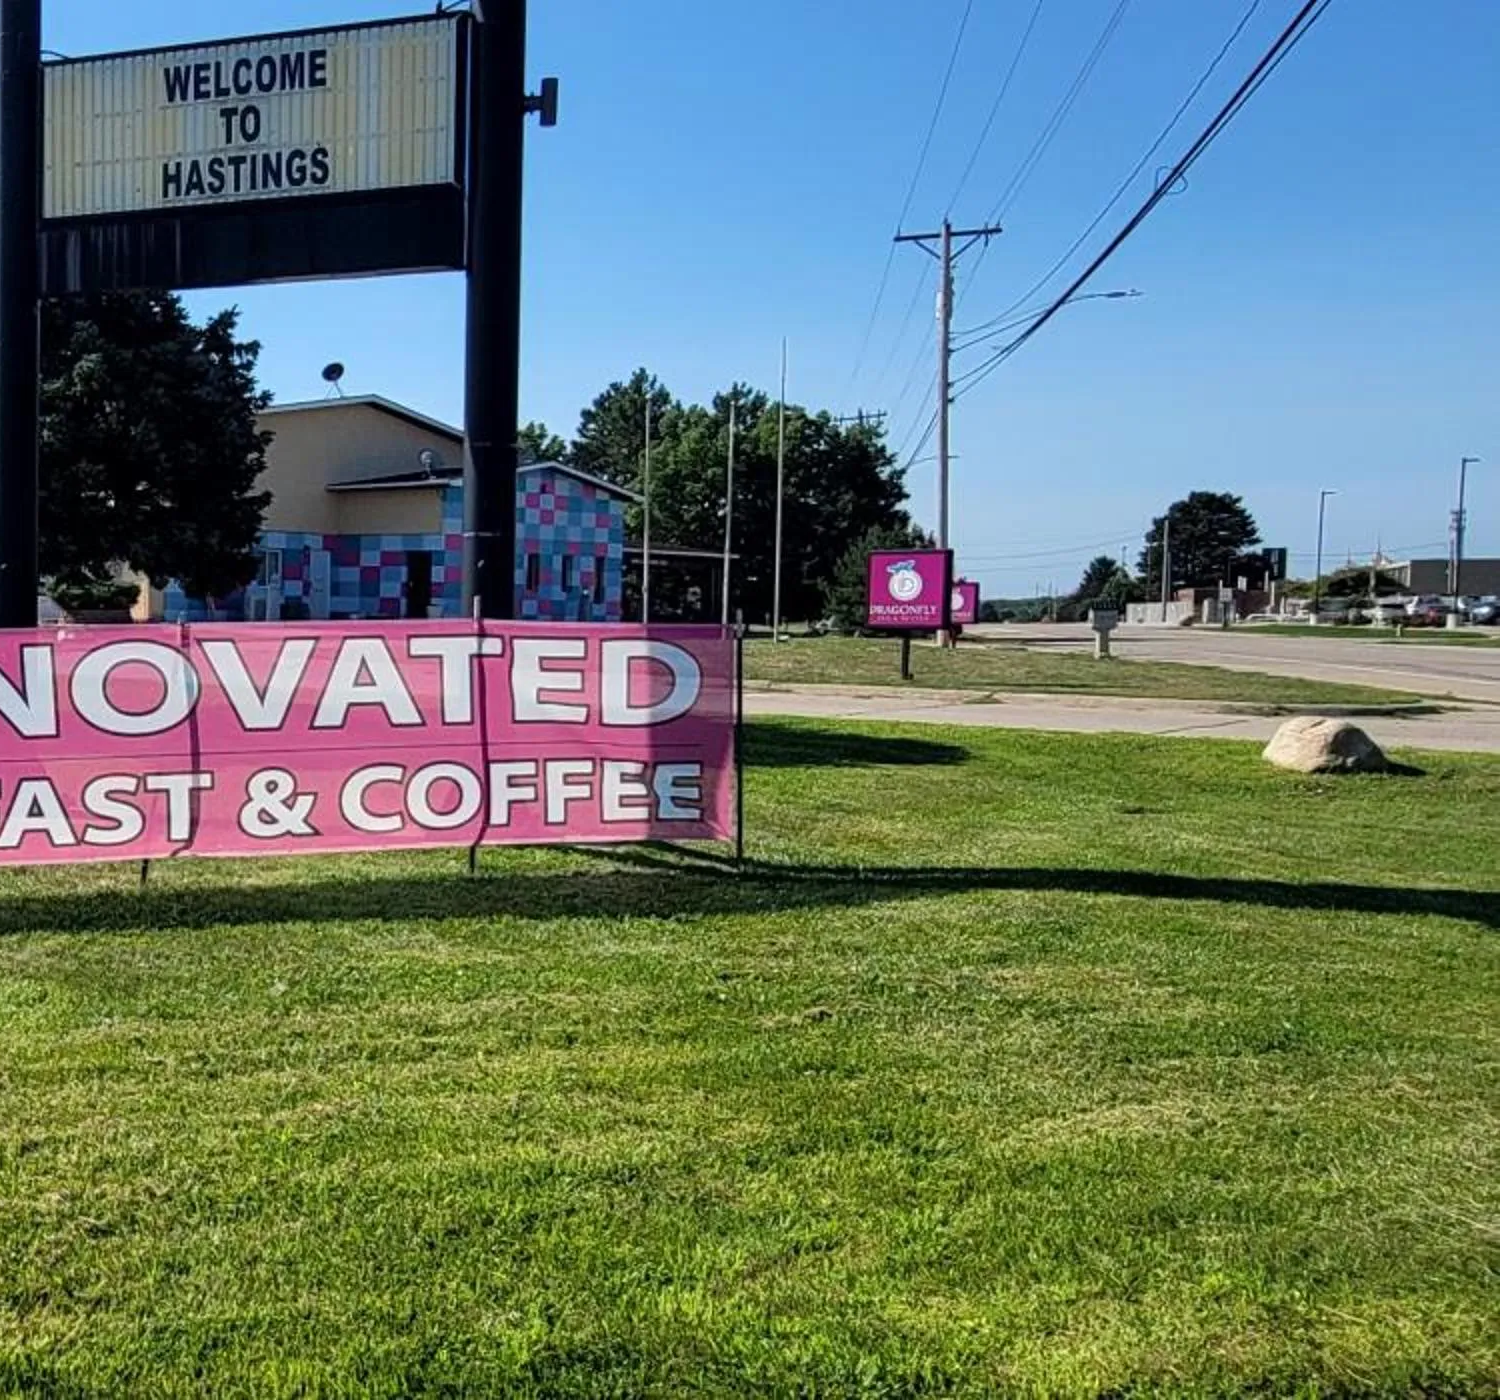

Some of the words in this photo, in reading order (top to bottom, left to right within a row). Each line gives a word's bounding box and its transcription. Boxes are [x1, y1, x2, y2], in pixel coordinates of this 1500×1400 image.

[163, 49, 328, 102] WELCOME
[219, 104, 261, 144] TO
[161, 146, 330, 199] HASTINGS
[869, 604, 937, 616] DRAGONFLY
[237, 766, 321, 839] &
[338, 757, 703, 833] COFFEE
